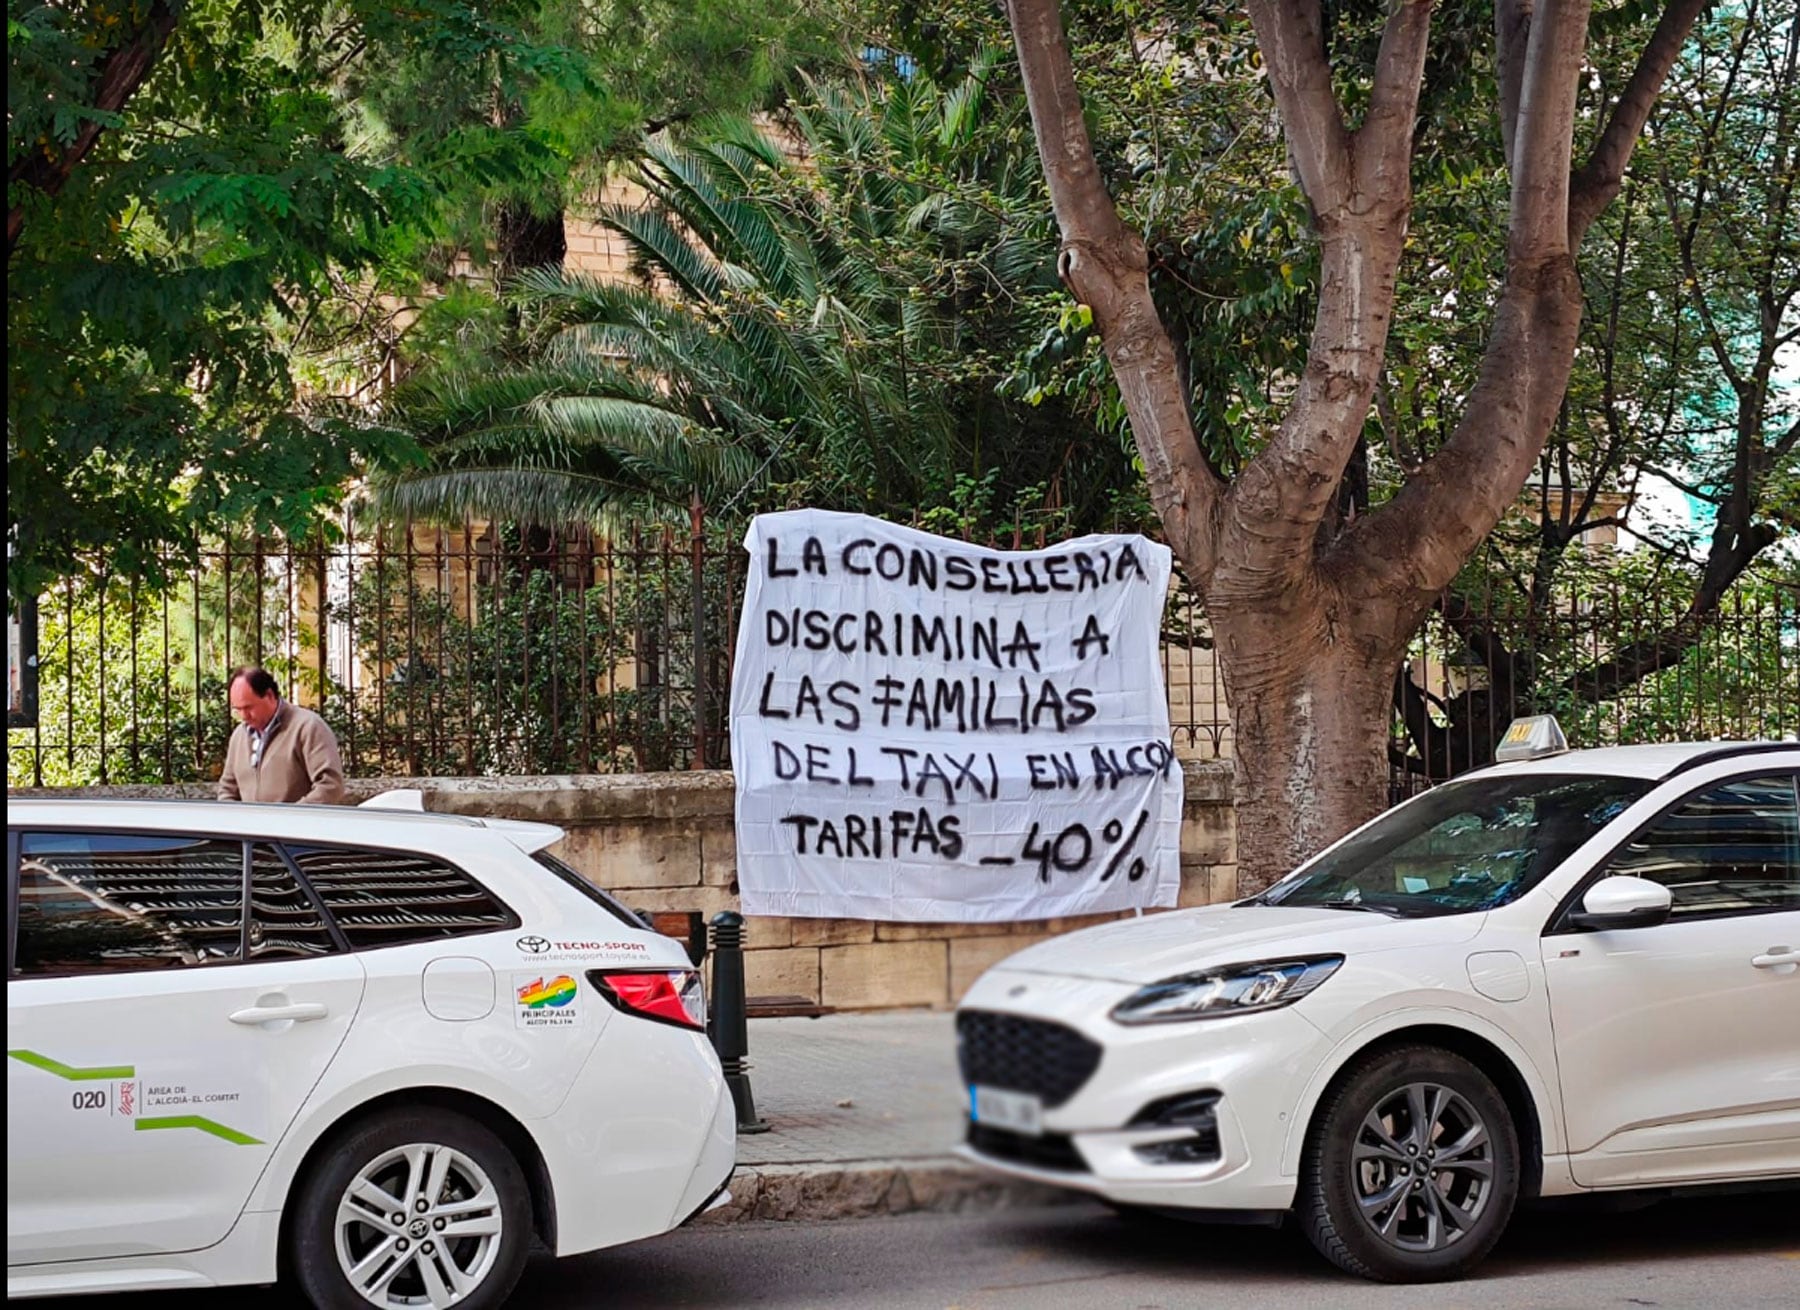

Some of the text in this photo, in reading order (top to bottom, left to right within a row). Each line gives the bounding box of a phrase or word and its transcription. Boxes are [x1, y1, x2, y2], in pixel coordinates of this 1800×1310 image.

[767, 537, 1149, 593] LA CONSELLERIA
[766, 608, 1109, 672] DISCRIMINA A
[759, 672, 1097, 734] LAS FAMILIAS
[772, 740, 1174, 804] DEL TAXI EN ALCOY
[780, 808, 963, 859] TARIFAS
[522, 1009, 576, 1018] PRINCIPALES
[72, 1091, 106, 1110] 020
